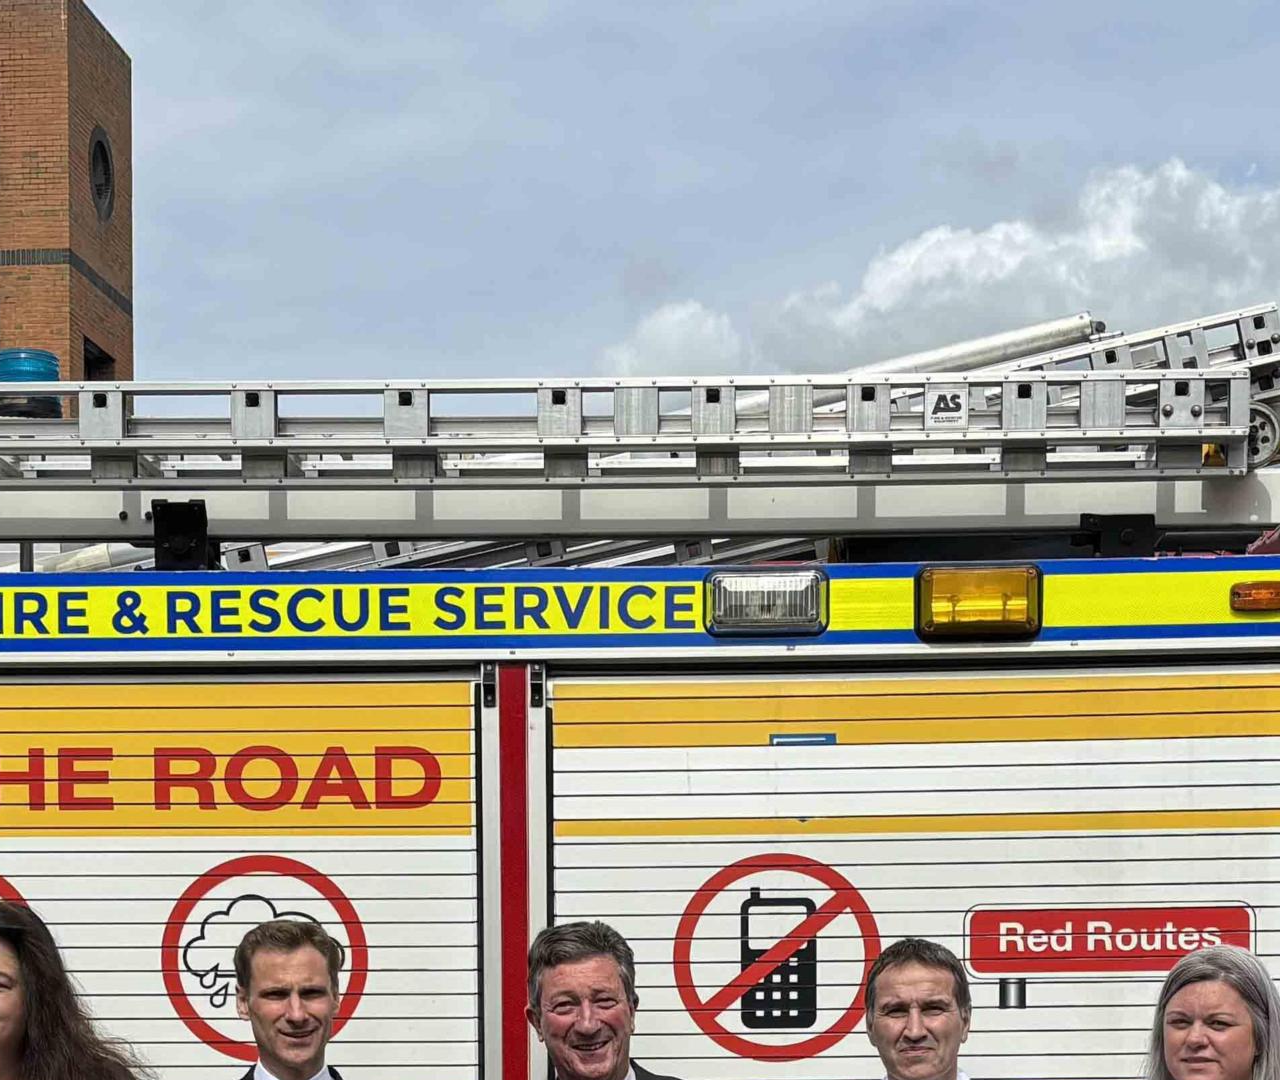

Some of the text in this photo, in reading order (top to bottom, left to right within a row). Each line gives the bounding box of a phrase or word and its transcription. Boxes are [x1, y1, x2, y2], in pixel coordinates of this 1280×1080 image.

[112, 591, 149, 634] &
[166, 589, 409, 633] RESCUE
[432, 585, 698, 631] SERVICE
[153, 745, 442, 811] ROAD
[998, 920, 1222, 953] Red Routes
